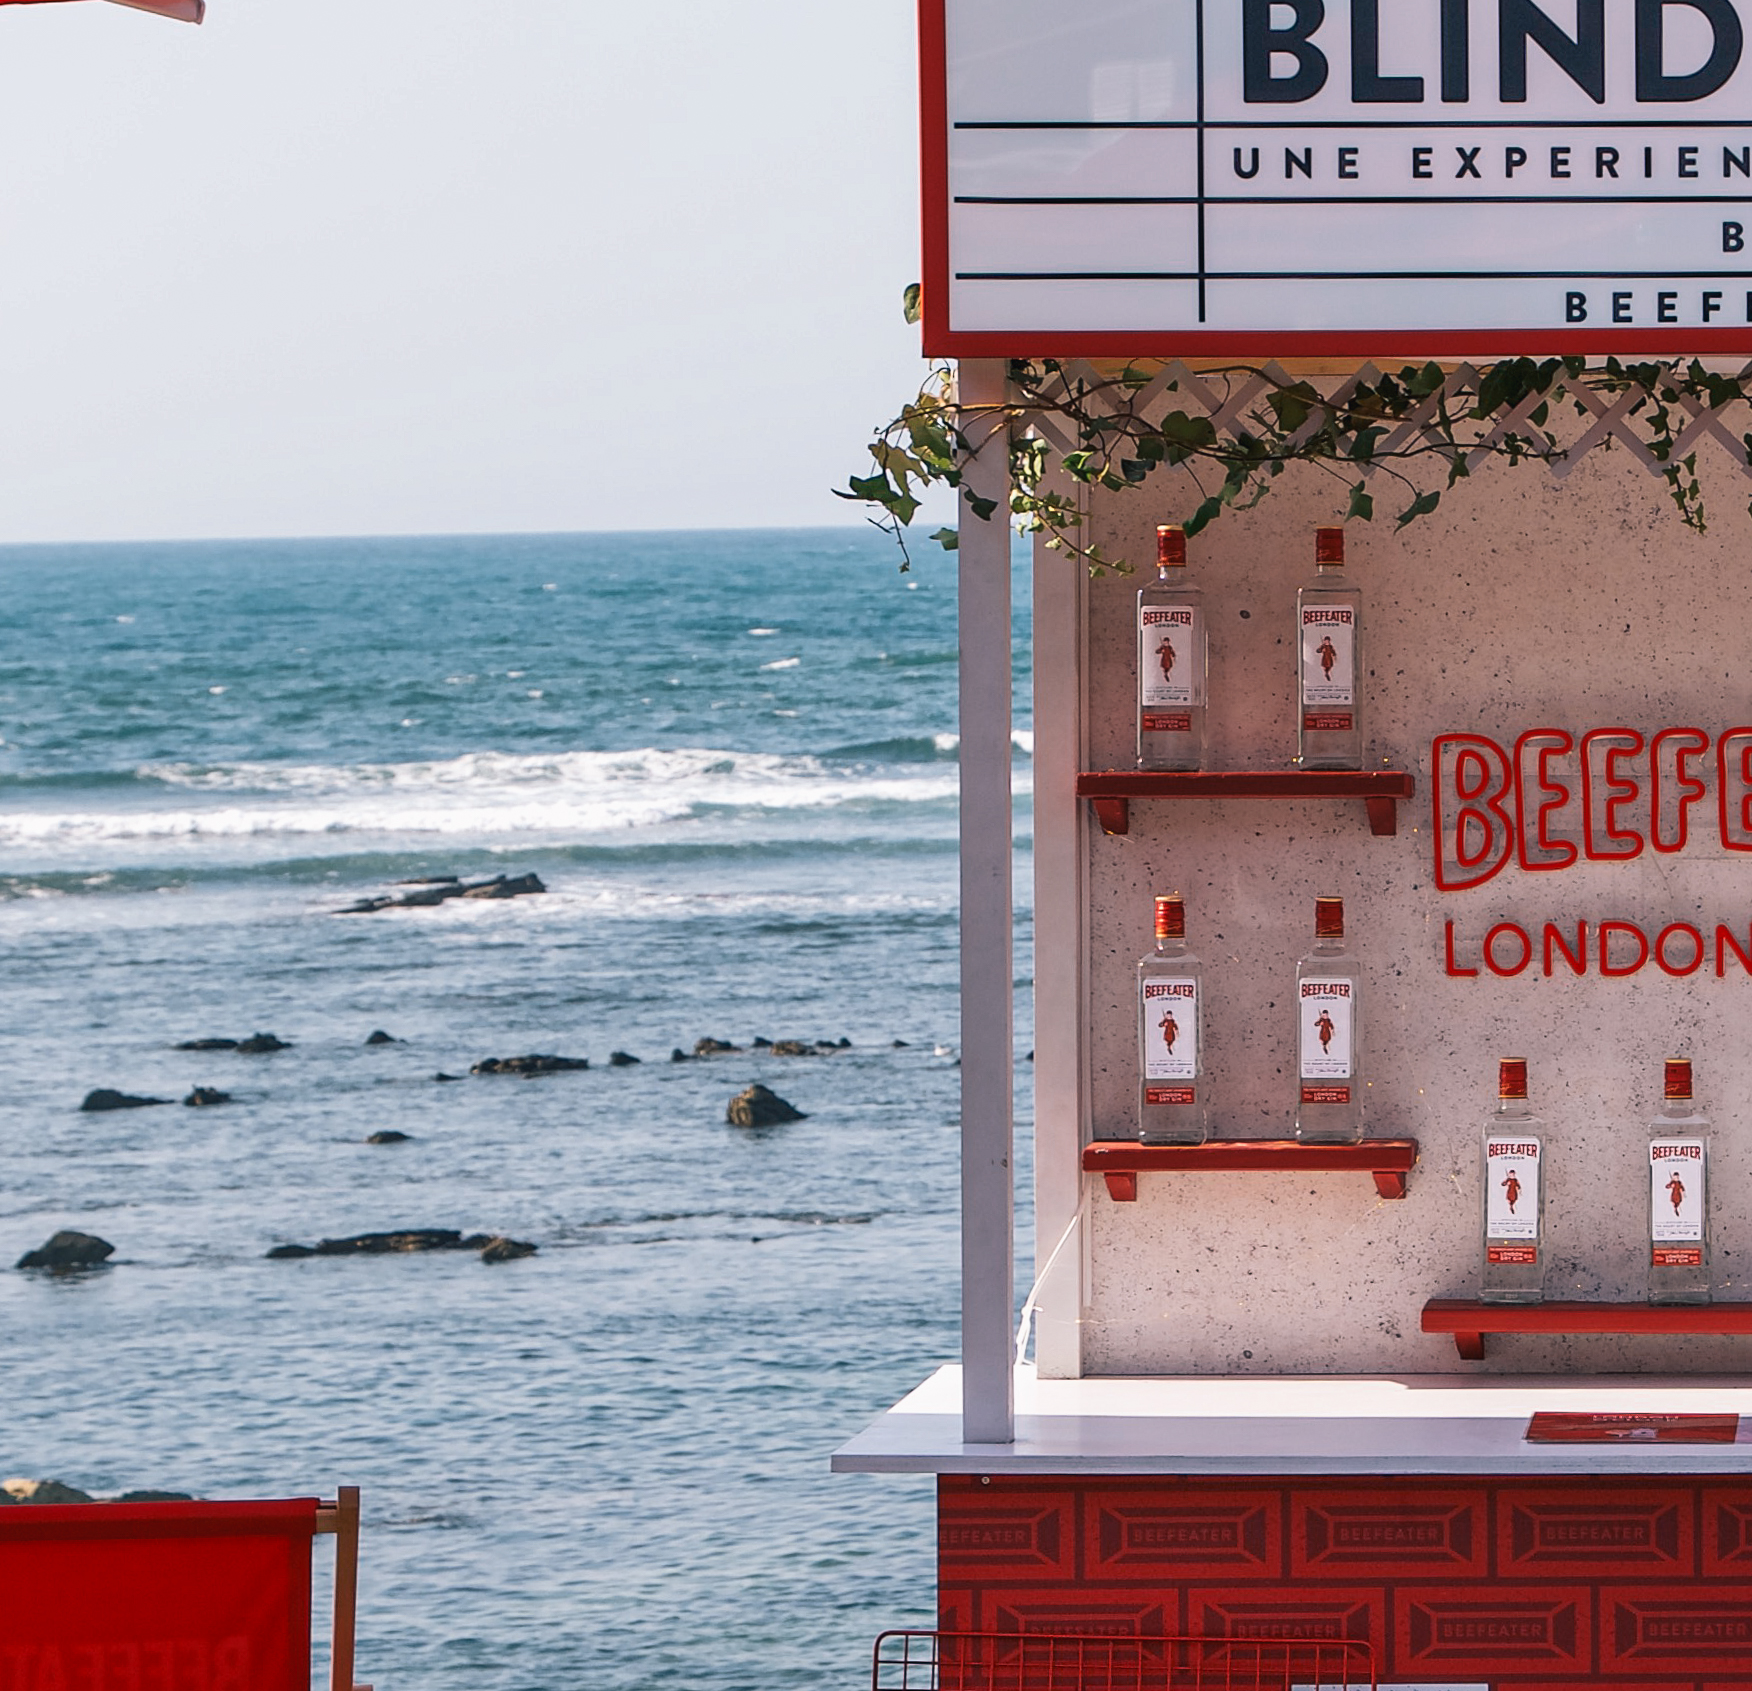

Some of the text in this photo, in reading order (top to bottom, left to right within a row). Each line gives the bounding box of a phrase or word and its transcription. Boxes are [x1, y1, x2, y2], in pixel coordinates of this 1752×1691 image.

[1234, 148, 1360, 180] UNE
[1143, 611, 1191, 626] BEEFEATER
[1303, 611, 1352, 625] BEEFEATER
[1145, 984, 1194, 999] BEEFEATER
[1301, 983, 1350, 998] BEEFEATER
[1489, 1143, 1537, 1158] BEEFEATER
[1652, 1146, 1701, 1161] BEEFEATER
[939, 1528, 1027, 1543] EEFEATER
[1133, 1527, 1233, 1542] BEEFEATER
[1339, 1526, 1439, 1541] BEEFEATER
[1545, 1525, 1645, 1540] BEEFEATER
[1443, 1622, 1543, 1637] BEEFEATER
[1648, 1621, 1748, 1636] BEEFEATER
